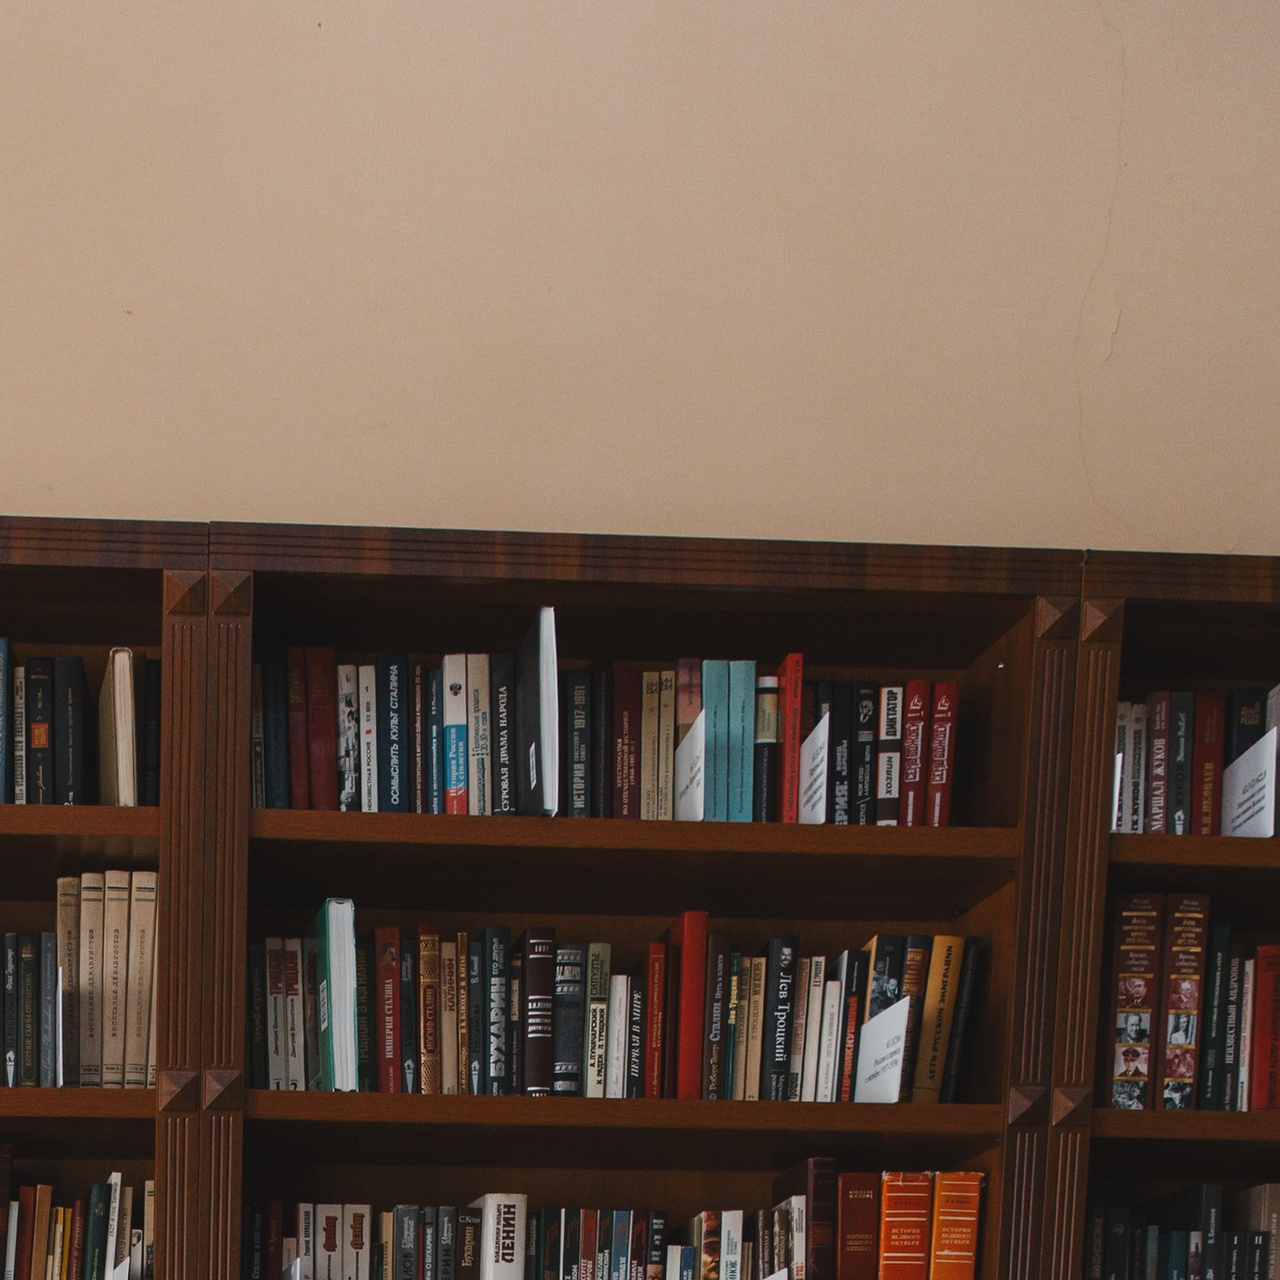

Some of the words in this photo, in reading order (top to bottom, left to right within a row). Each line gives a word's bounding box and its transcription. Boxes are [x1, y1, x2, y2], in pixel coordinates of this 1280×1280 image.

[389, 665, 398, 708] СТАЛИНА
[499, 686, 508, 727] НАРОДА
[573, 685, 586, 729] 1917-1991
[390, 711, 399, 741] КУЛЬТ
[885, 690, 898, 736] ДИКТАТОР
[449, 728, 457, 758] России
[500, 730, 509, 764] ДРАМА
[1153, 738, 1166, 776] ЖУКОВ
[390, 743, 400, 805] ОСМЫСЛИТЬ
[450, 760, 458, 796] История
[501, 767, 510, 812] СУРОВАЯ
[573, 763, 586, 808] ИСТОРИЯ
[885, 756, 893, 795] ХОЗЯИН
[1132, 781, 1140, 816] ЖУКОВ
[1152, 781, 1164, 831] МАРШАЛ
[384, 979, 393, 1014] СТАЛИНА
[425, 989, 434, 1020] СТАЛИН
[447, 958, 455, 1012] КАЛИНИН
[779, 971, 792, 999] Лев
[632, 990, 642, 1022] МИРЕ
[927, 1055, 939, 1082] ДЕТИ
[939, 946, 953, 1004] ЭМИГРАЦИИ
[385, 1017, 394, 1058] ИМПЕРИЯ
[426, 1022, 434, 1050] ИОСИФ
[490, 977, 506, 1077] БУХАРИН
[773, 1002, 789, 1062] Троцкий
[631, 1034, 640, 1078] ПЕРВАЯ
[462, 1226, 474, 1266] Бухарин
[502, 1204, 516, 1264] ЛЕНИН
